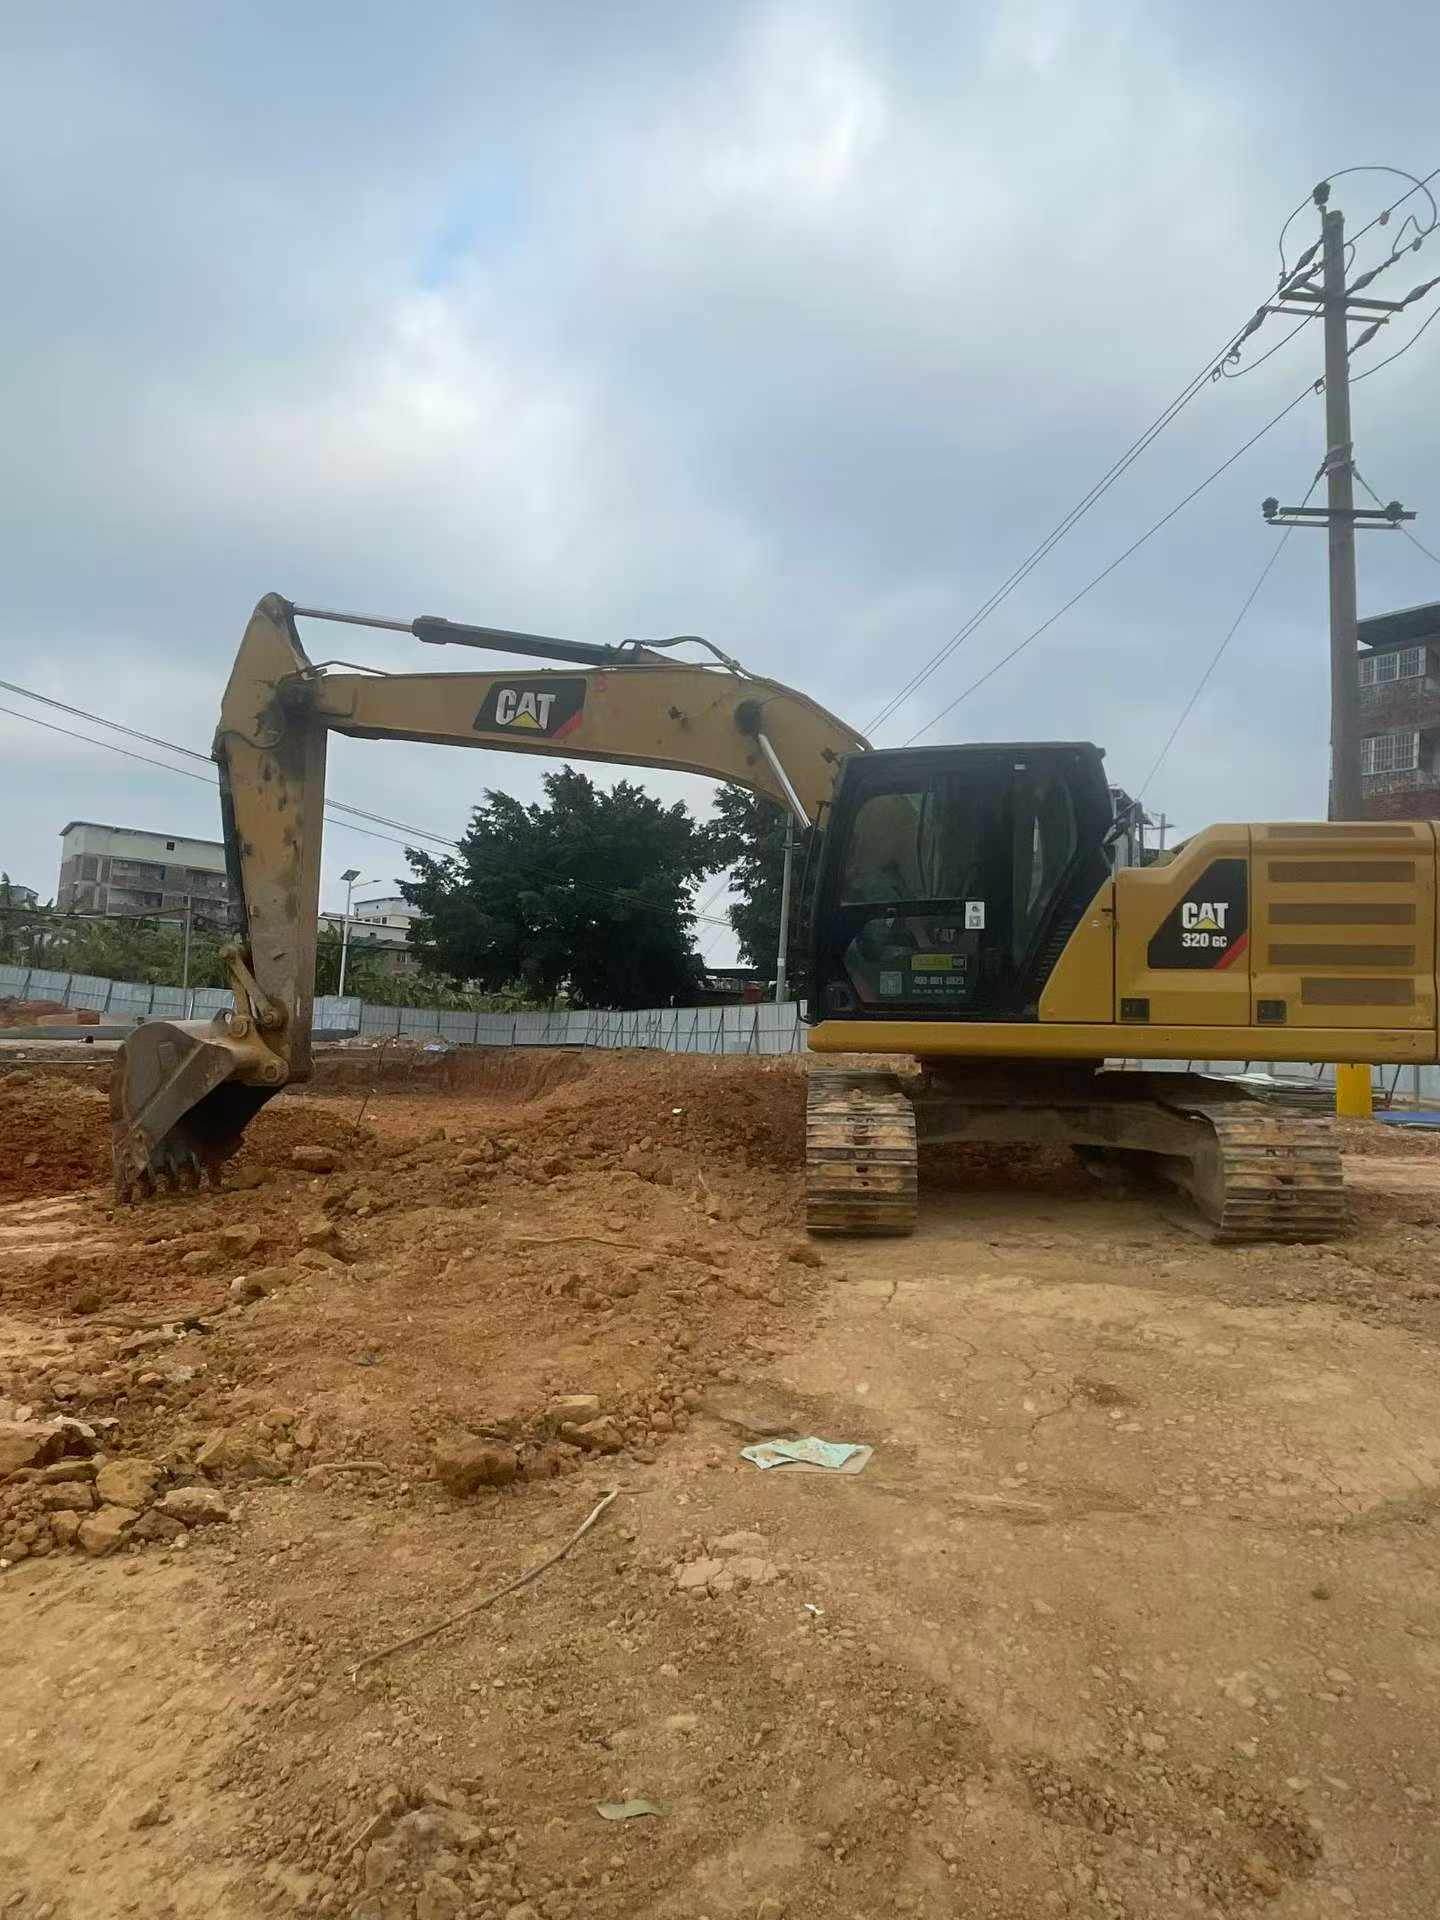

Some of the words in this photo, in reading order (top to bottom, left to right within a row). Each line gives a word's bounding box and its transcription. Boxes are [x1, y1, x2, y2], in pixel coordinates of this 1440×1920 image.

[495, 689, 556, 730] CAT
[1182, 902, 1229, 929] CAT
[1182, 933, 1209, 947] 320
[1212, 936, 1227, 947] GC
